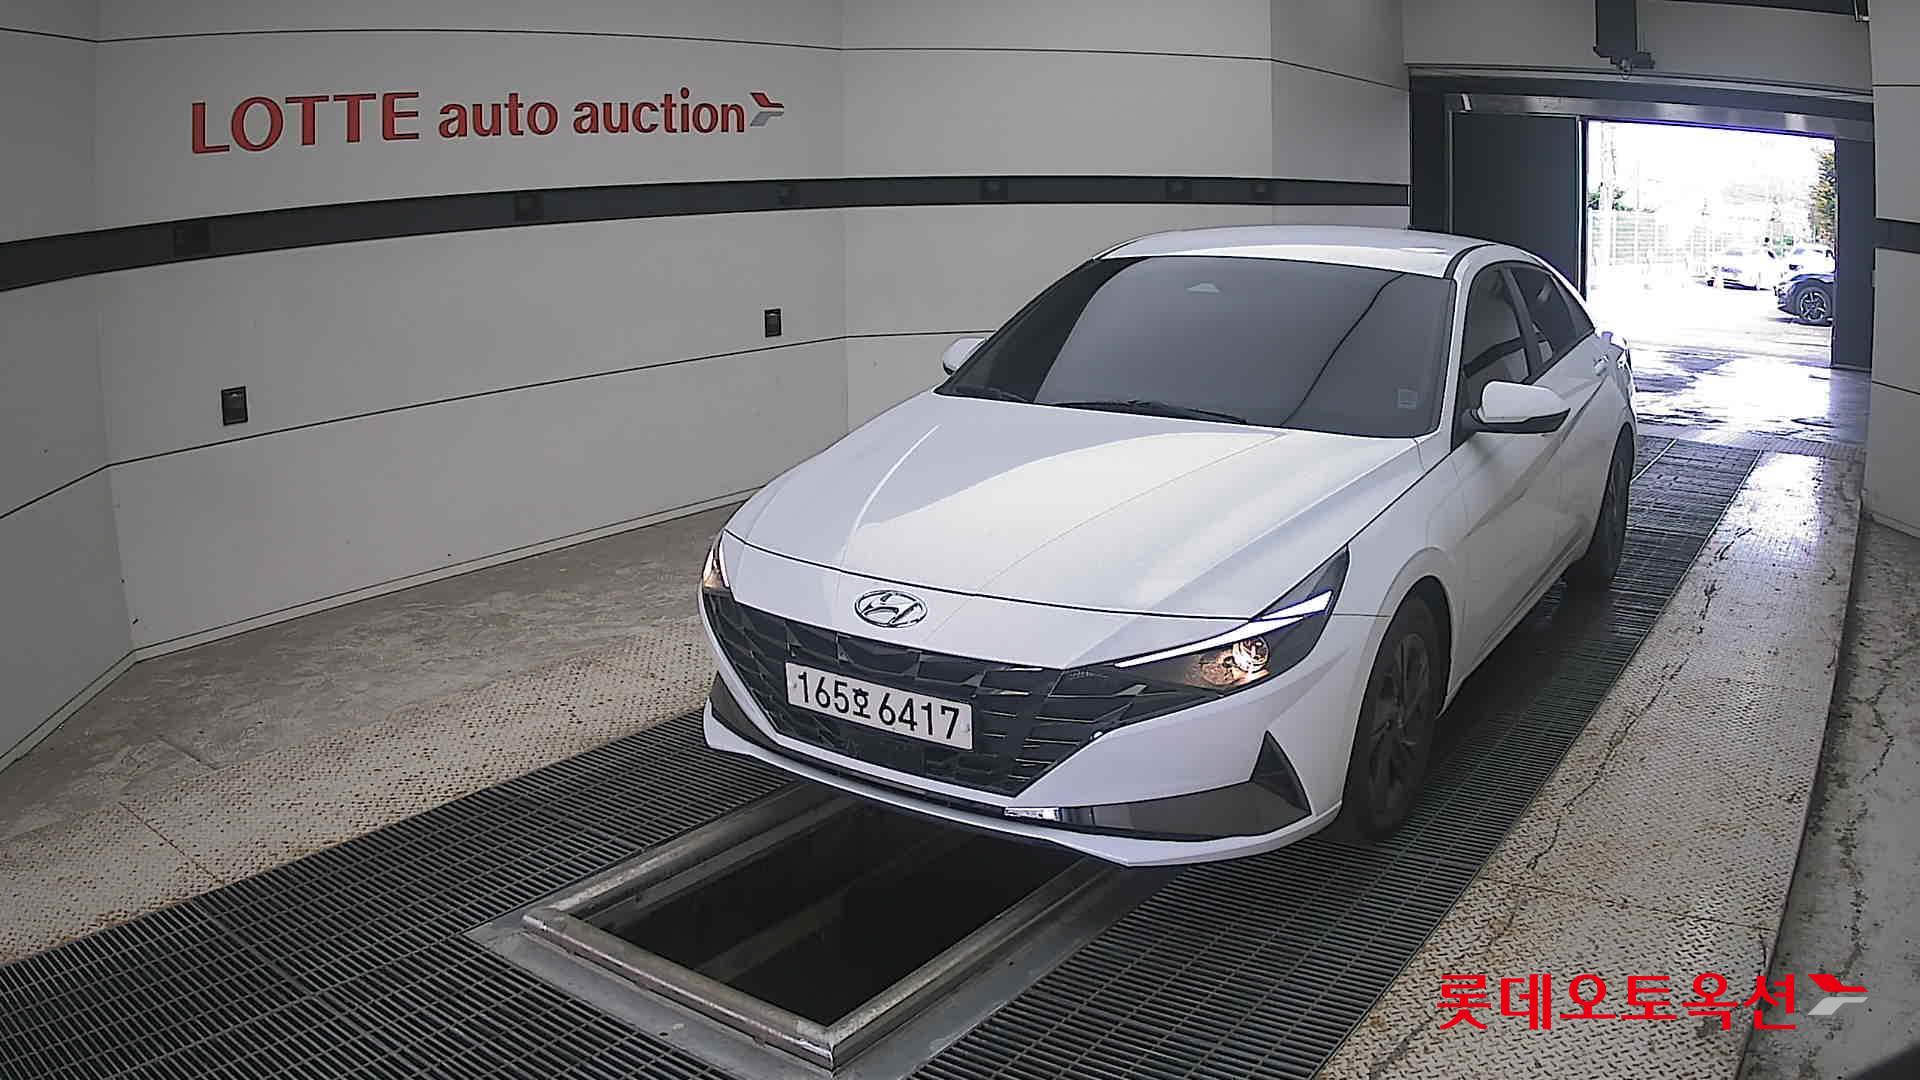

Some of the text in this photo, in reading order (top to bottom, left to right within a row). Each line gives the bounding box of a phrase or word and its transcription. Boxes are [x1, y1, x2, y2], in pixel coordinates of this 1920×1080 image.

[192, 87, 746, 154] LOTTE auto auction
[878, 692, 960, 739] 6417
